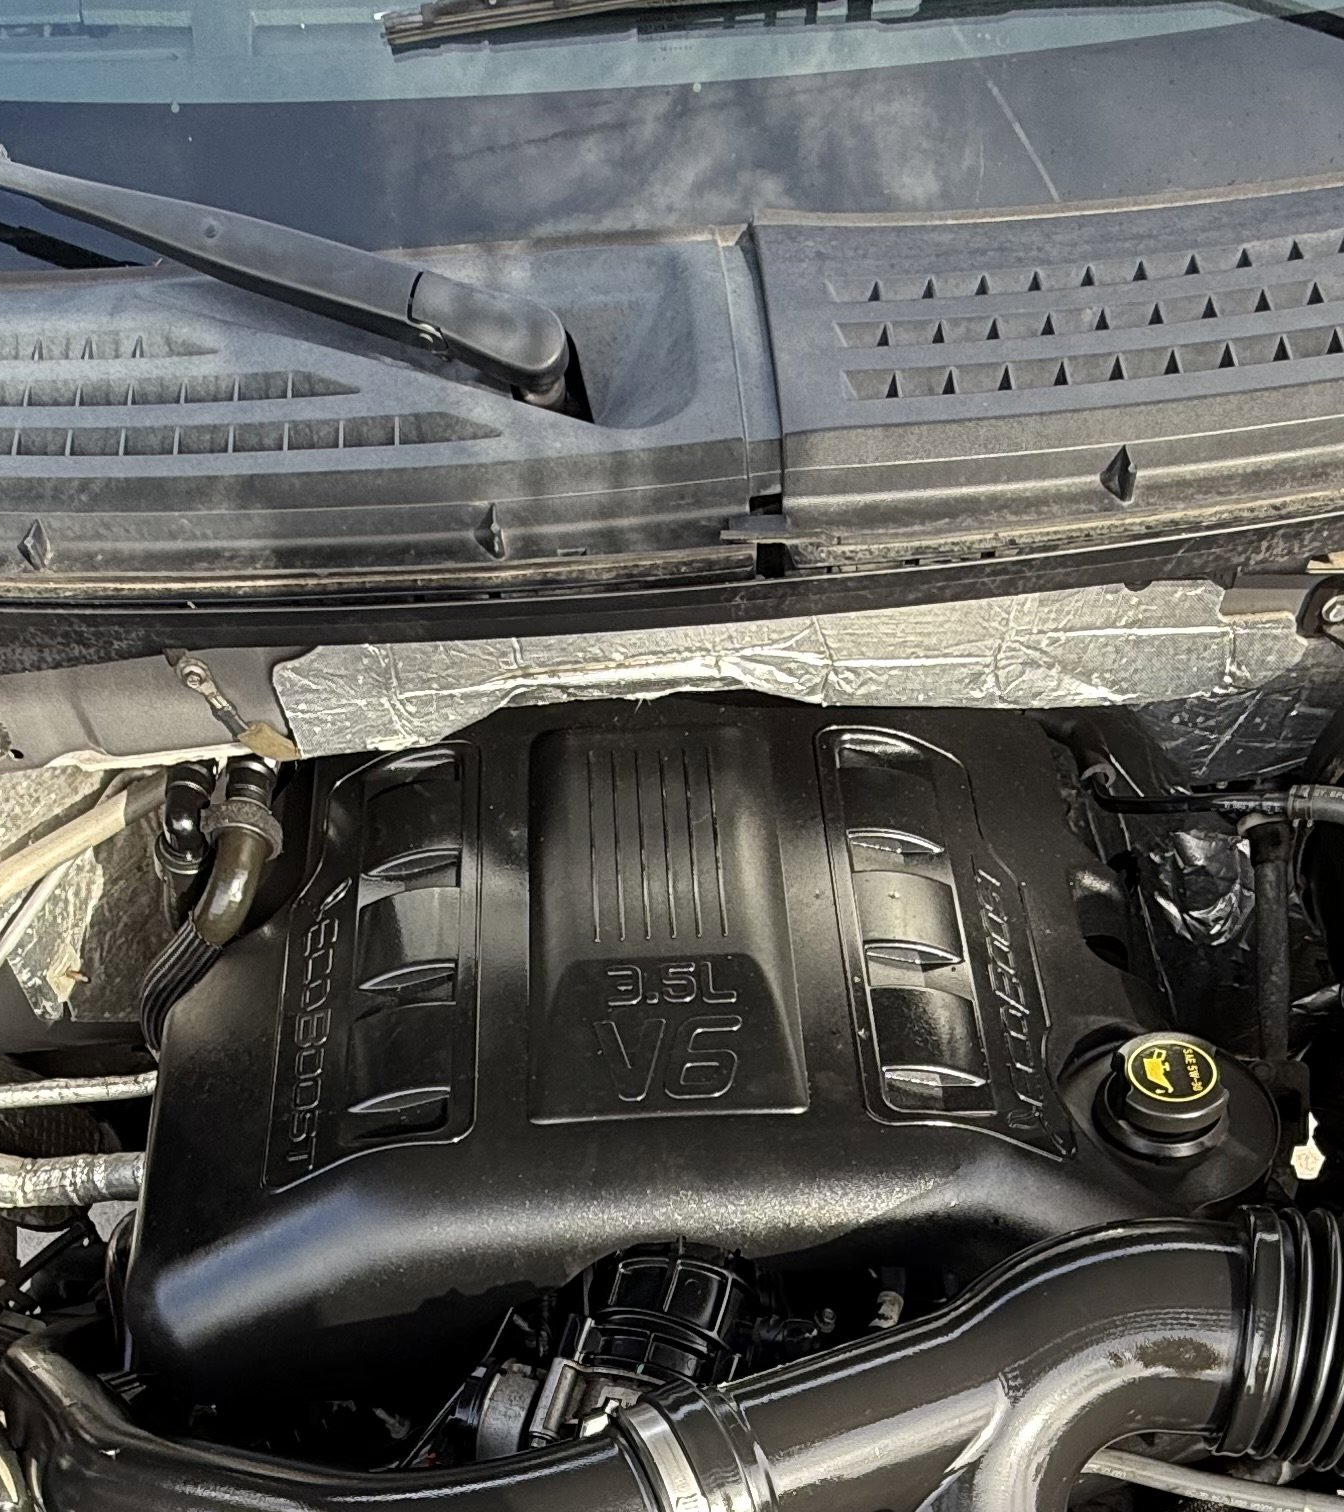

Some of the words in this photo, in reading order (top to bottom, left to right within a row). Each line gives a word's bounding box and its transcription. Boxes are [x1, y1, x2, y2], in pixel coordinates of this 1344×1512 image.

[607, 961, 737, 1006] 3.5L
[285, 917, 339, 1171] ECOBOOST
[592, 1014, 743, 1102] V6
[1182, 1047, 1195, 1064] SAE
[1186, 1064, 1203, 1091] 5W-30
